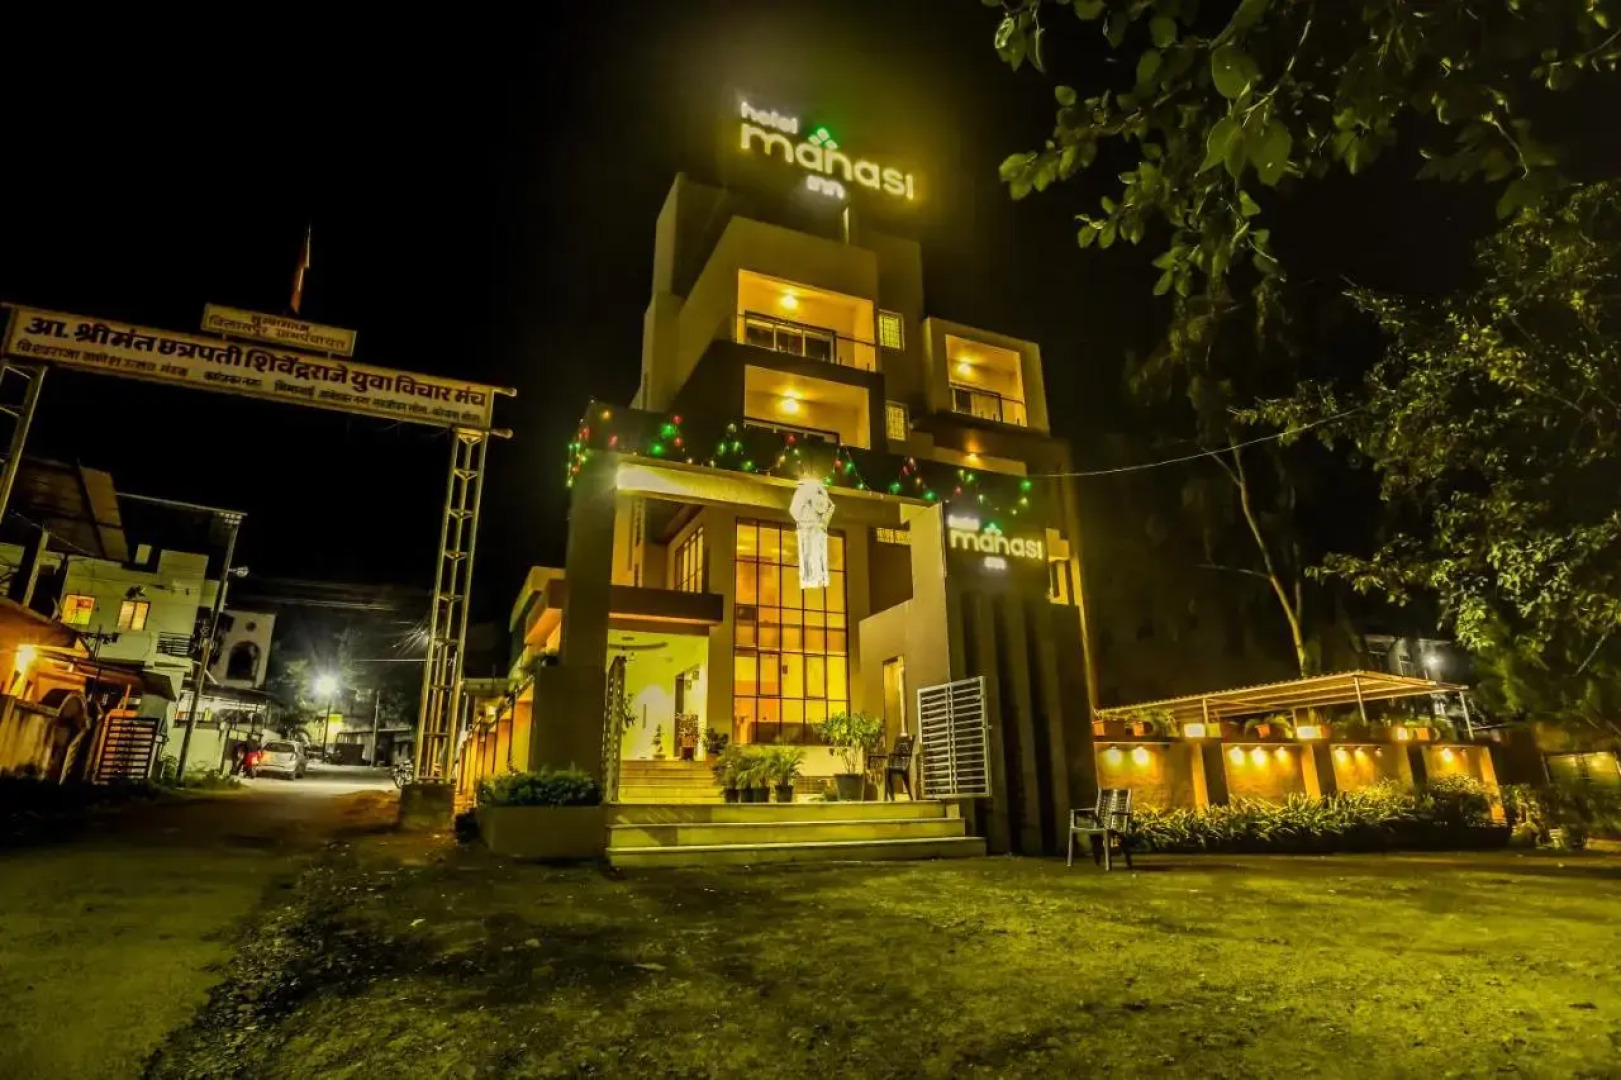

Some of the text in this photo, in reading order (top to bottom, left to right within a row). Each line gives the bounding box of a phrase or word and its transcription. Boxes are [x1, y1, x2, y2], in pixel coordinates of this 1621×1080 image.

[74, 321, 158, 352] श्रीमंत
[158, 336, 243, 367] छत्रपती
[350, 370, 392, 392] युवा
[395, 375, 450, 401] विचार
[454, 386, 486, 407] मंच
[949, 528, 1043, 560] manasi
